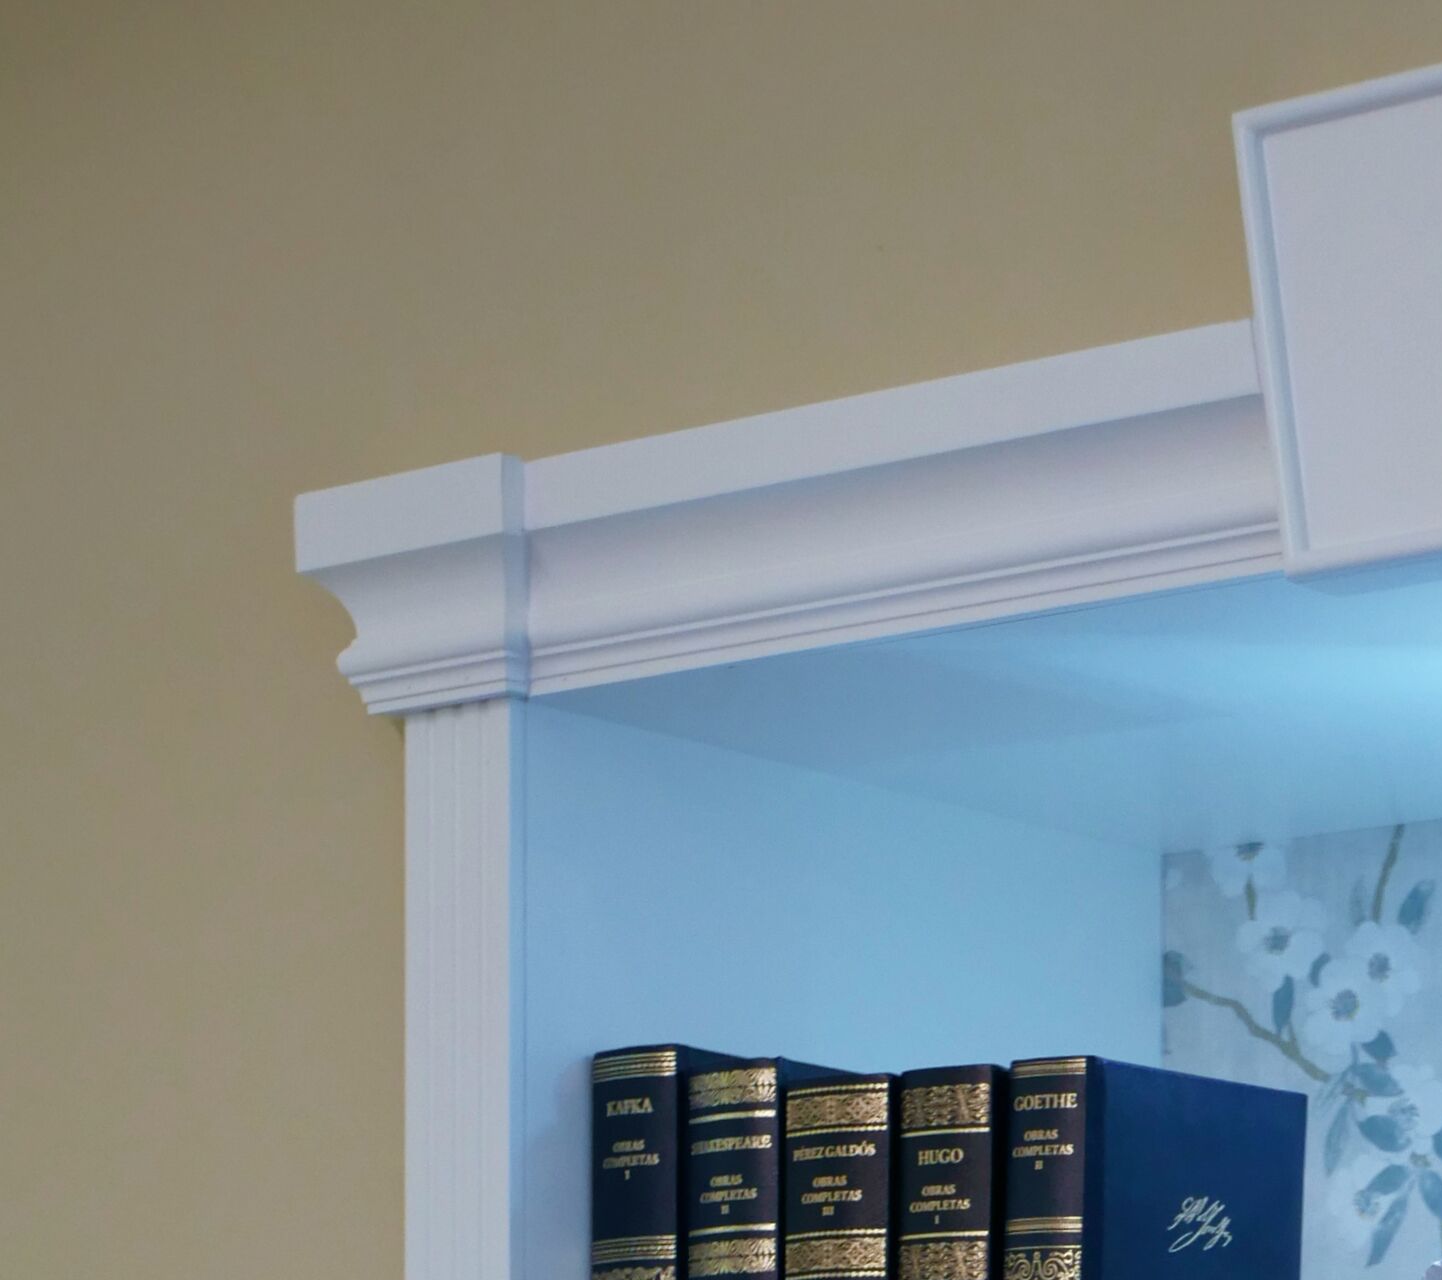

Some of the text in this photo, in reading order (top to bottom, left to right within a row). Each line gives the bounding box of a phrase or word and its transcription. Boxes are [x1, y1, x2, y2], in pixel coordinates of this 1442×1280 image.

[606, 1097, 654, 1117] KAFKA
[1013, 1092, 1078, 1111] GOETHE
[1023, 1129, 1059, 1141] OBRAS
[691, 1134, 772, 1156] SHAKESPEARE
[824, 1140, 876, 1159] GALDÓS
[1012, 1144, 1074, 1158] COMPLETAS
[602, 1153, 661, 1169] COMPLETAS
[917, 1148, 964, 1166] HUGO
[812, 1175, 848, 1187] OBRAS
[700, 1188, 758, 1204] COMPLETAS
[801, 1189, 863, 1205] COMPLETAS
[921, 1184, 956, 1197] OBRAS
[822, 1205, 835, 1216] III
[909, 1198, 971, 1213] COMPLETAS
